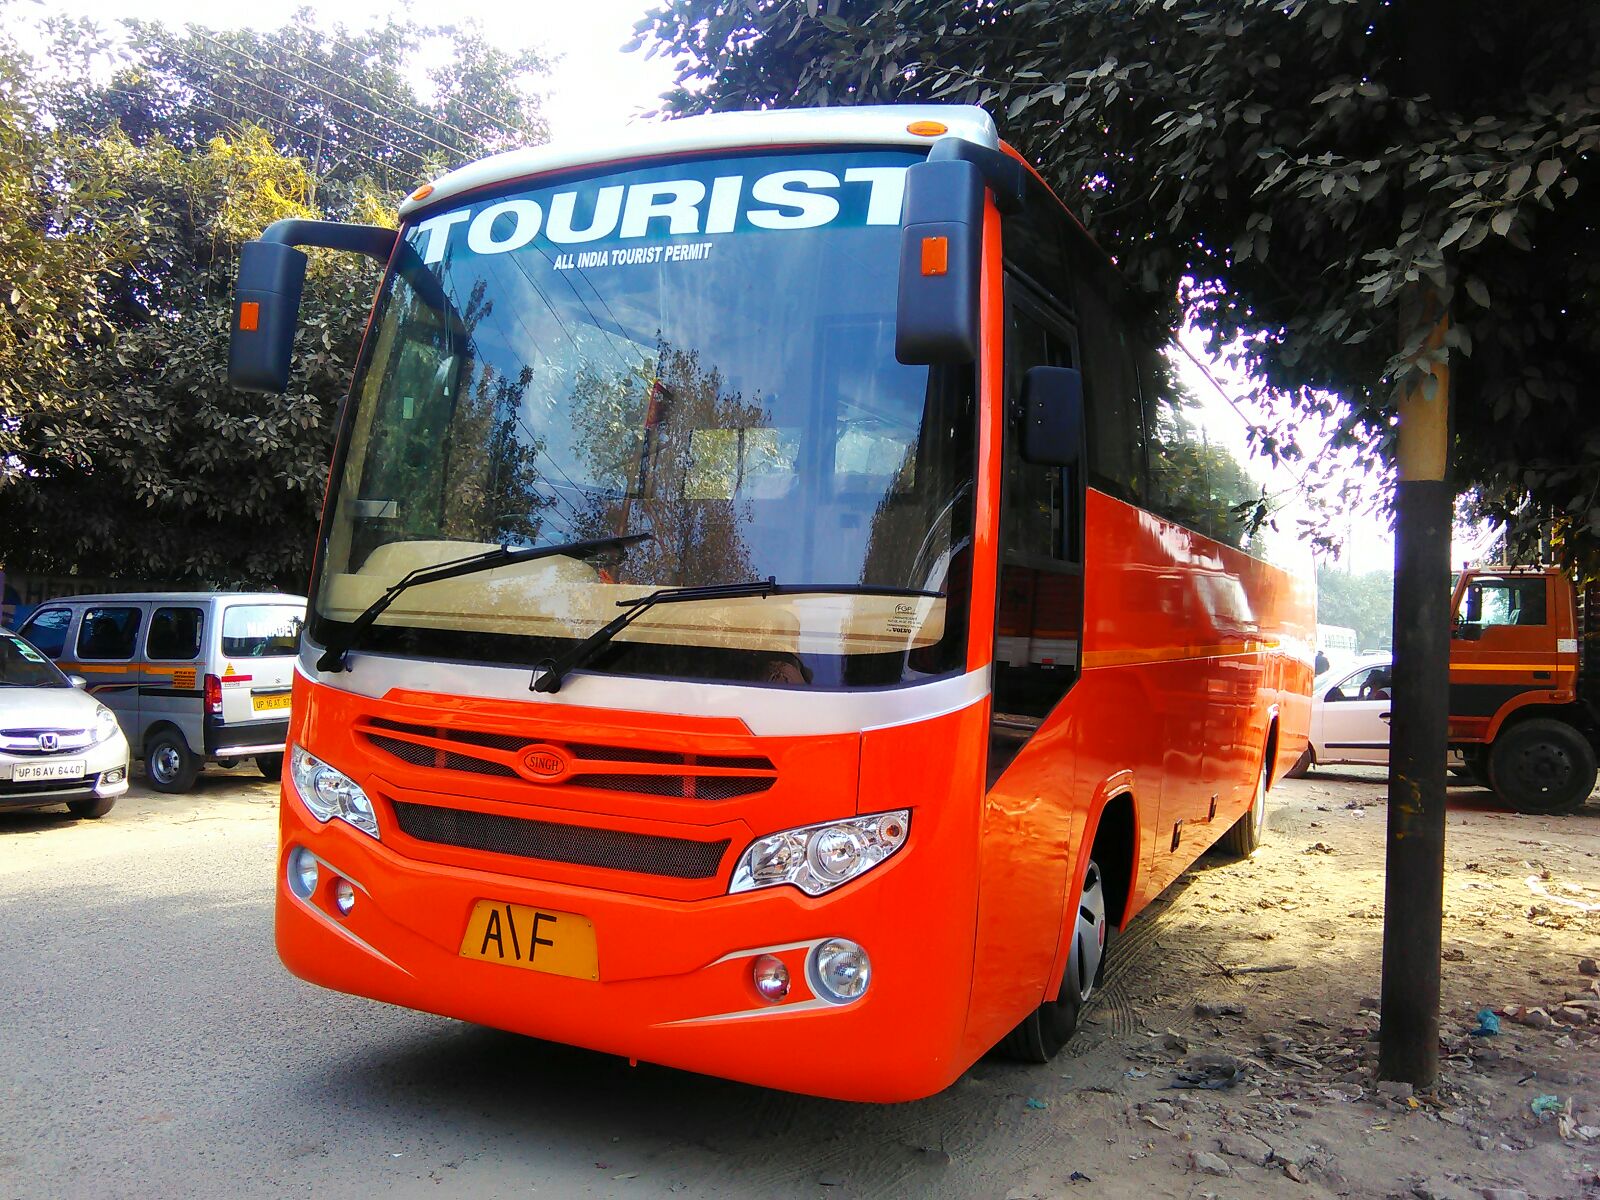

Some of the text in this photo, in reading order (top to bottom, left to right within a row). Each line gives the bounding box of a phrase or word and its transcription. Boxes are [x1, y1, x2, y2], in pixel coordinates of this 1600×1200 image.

[418, 167, 906, 265] TOURIST
[553, 243, 713, 270] ALL INDIA TOURIST PERMIT
[256, 701, 264, 709] UP
[529, 756, 559, 771] SINGH
[18, 765, 81, 778] UP 16 AV 6440
